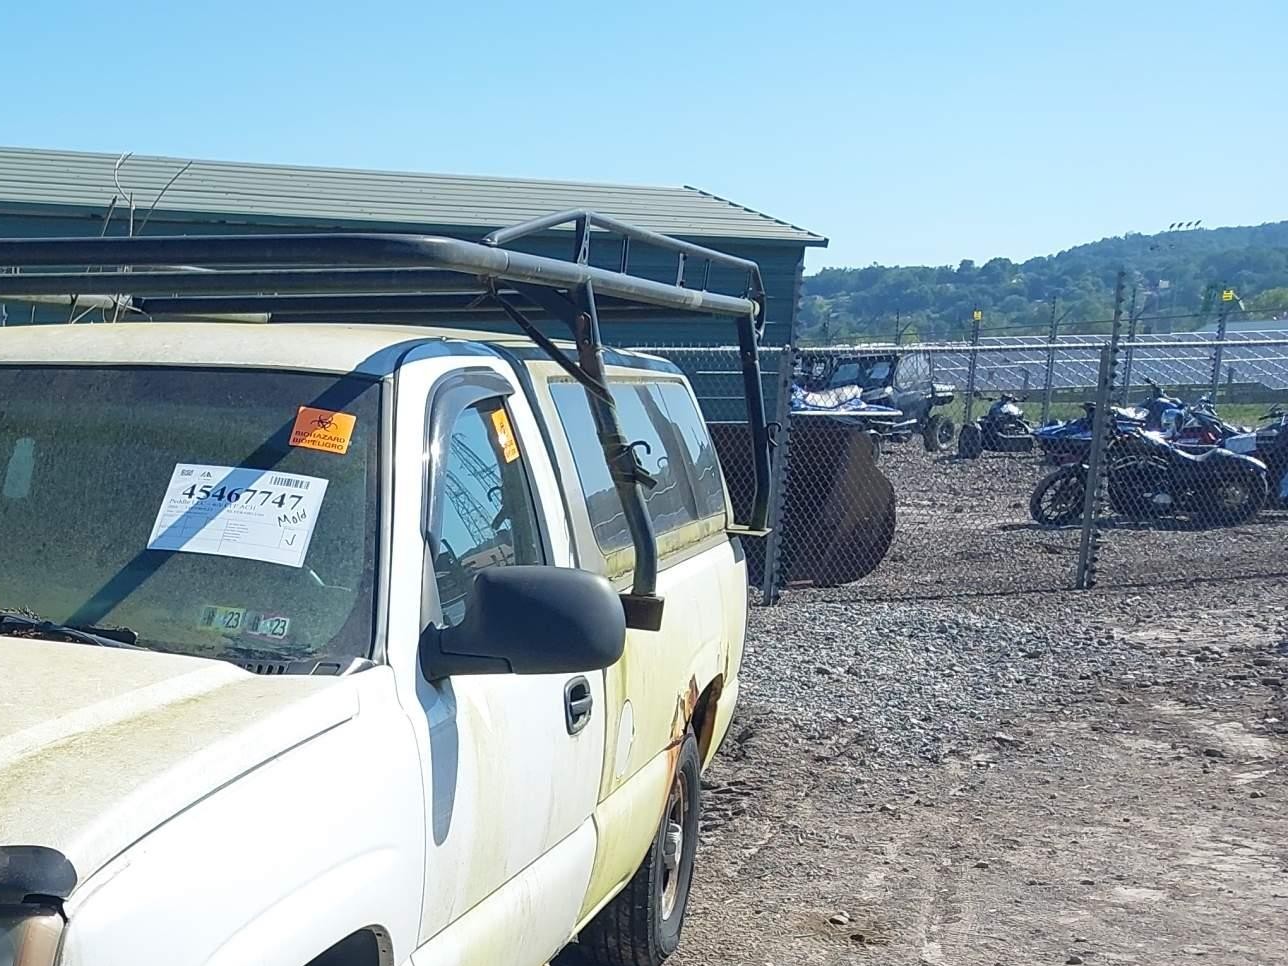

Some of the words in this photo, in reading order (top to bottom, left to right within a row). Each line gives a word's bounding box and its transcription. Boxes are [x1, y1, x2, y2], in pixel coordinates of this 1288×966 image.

[295, 430, 346, 444] BIOHAZARD
[182, 483, 304, 511] 45467747
[277, 508, 307, 528] Mold
[225, 611, 241, 629] 23
[271, 619, 287, 636] 23
